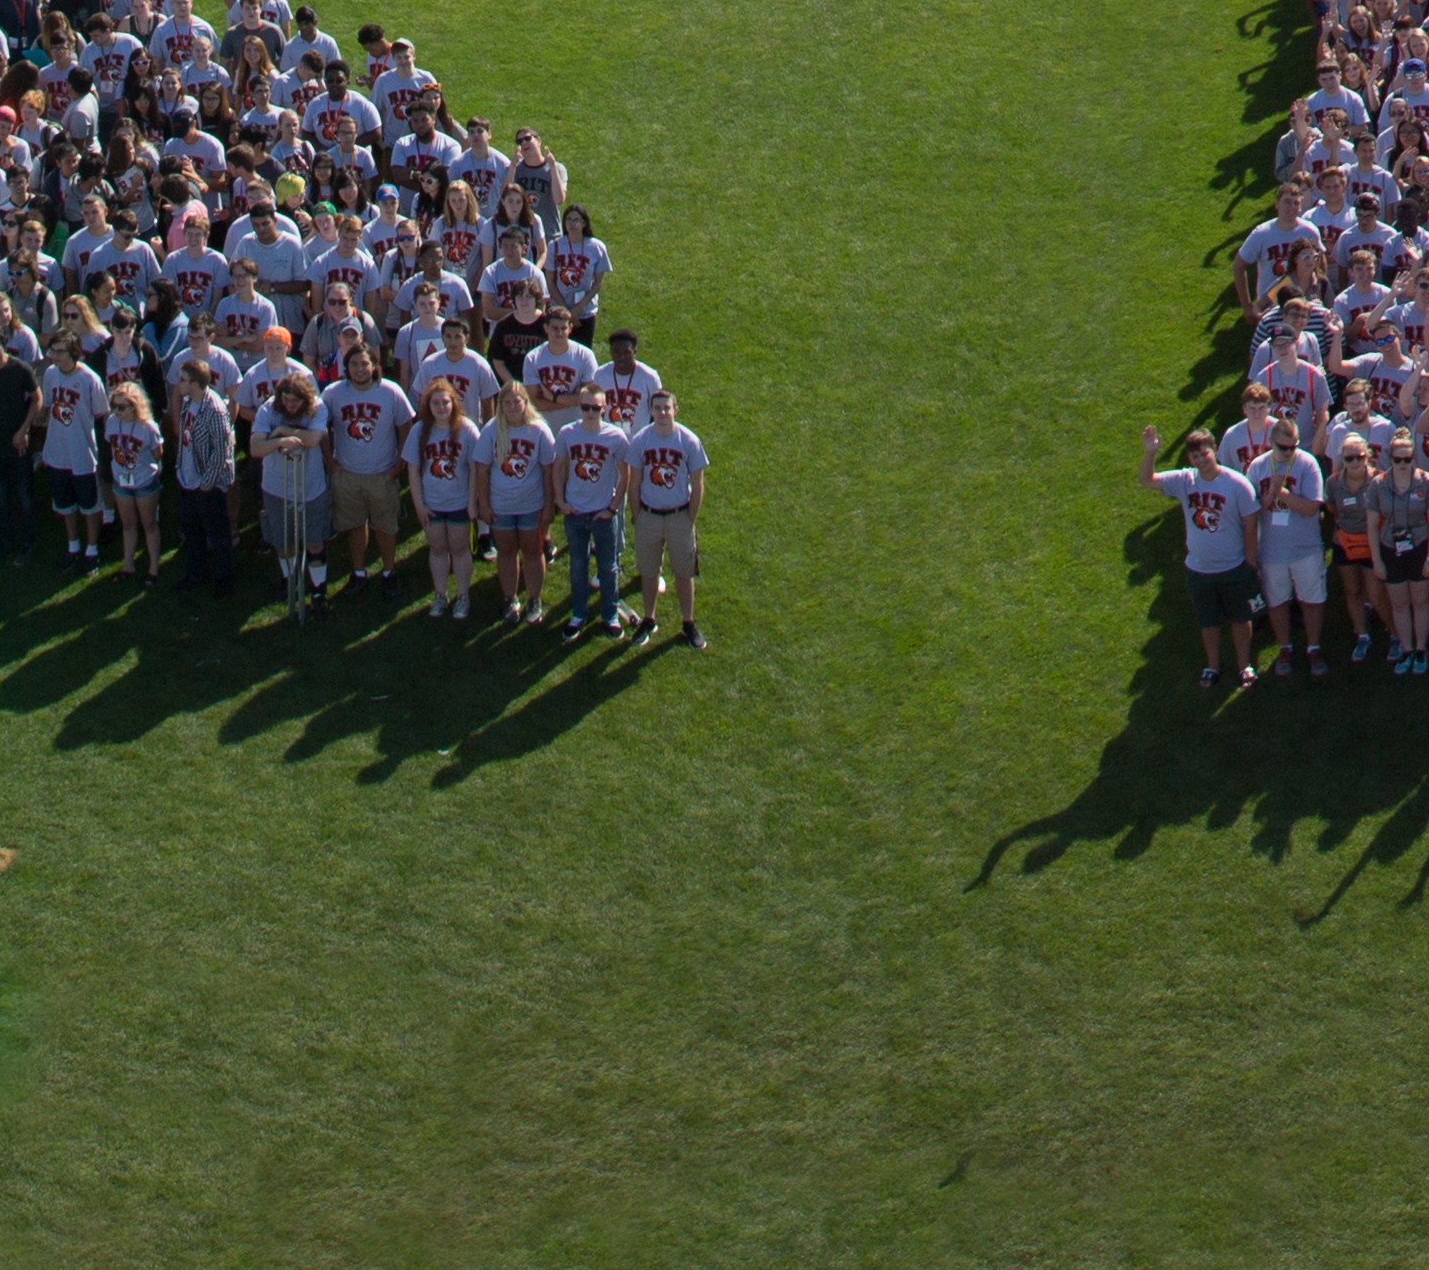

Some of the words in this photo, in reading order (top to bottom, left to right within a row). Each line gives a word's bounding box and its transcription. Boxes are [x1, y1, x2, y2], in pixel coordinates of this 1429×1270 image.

[517, 177, 550, 193] RIT
[176, 271, 212, 290] RIT
[327, 268, 364, 285] RIT
[538, 365, 575, 385] RIT
[341, 403, 381, 424] RIT
[495, 439, 535, 457] IT
[570, 444, 609, 464] RIT
[644, 448, 683, 469] RIT
[1188, 492, 1225, 512] RIT
